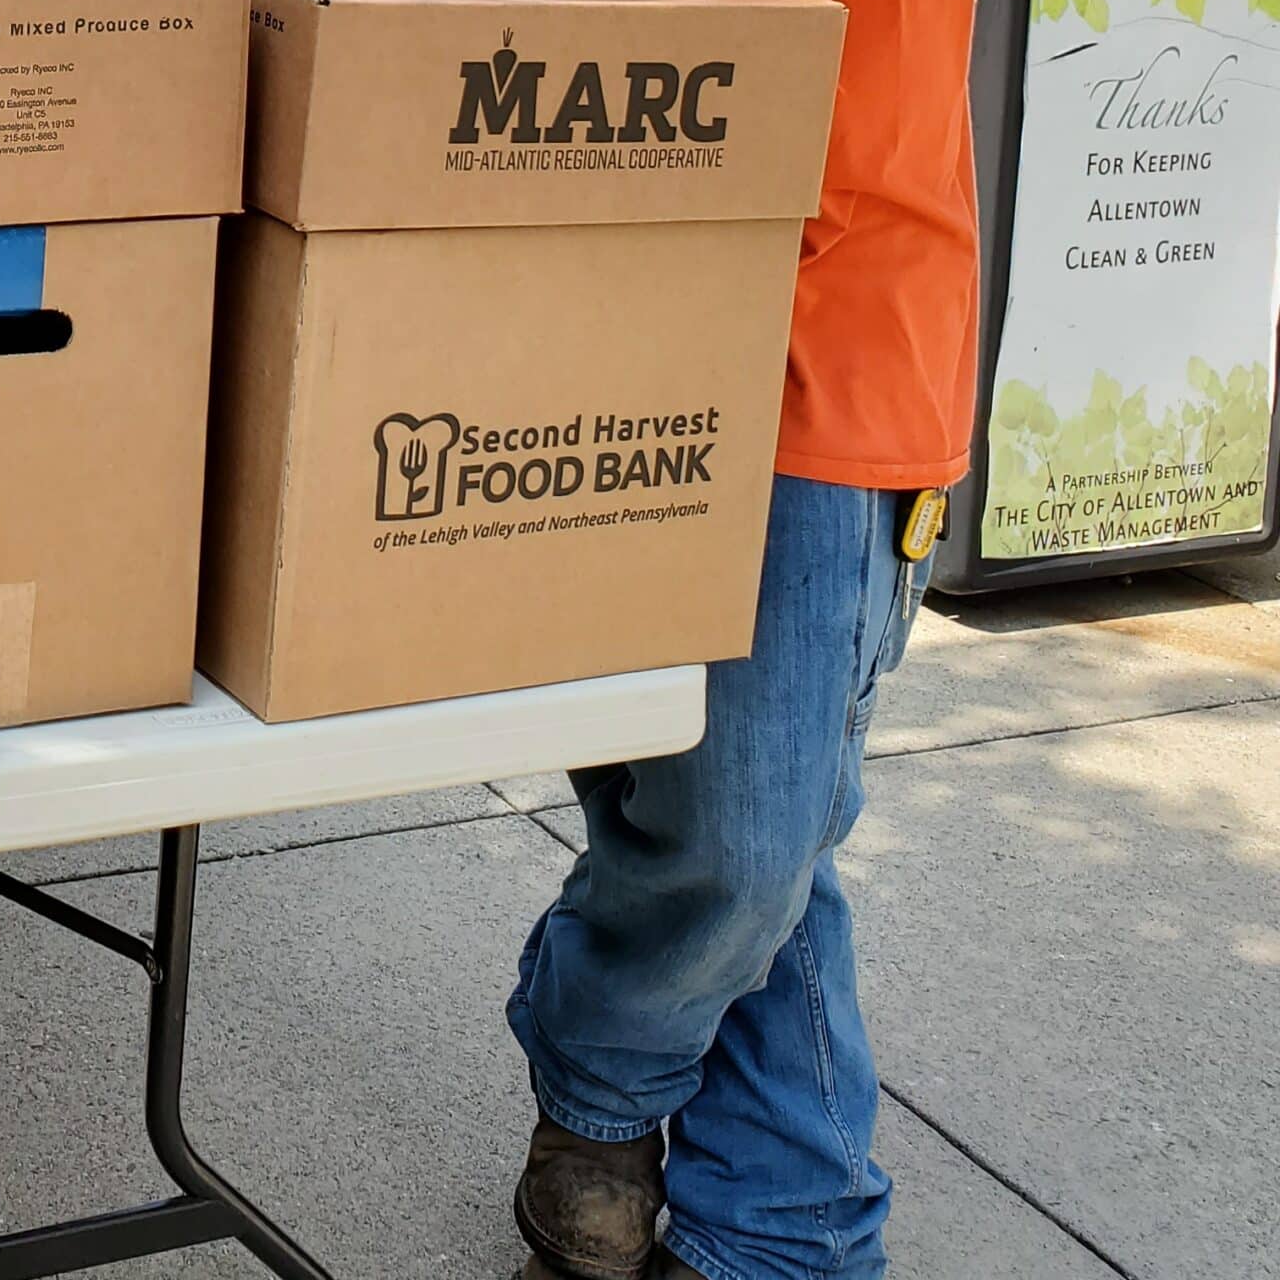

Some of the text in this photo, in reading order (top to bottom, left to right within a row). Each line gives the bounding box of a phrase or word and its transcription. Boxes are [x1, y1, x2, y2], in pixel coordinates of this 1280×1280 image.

[11, 21, 66, 37] Mixed
[75, 18, 150, 34] Produce
[159, 17, 195, 30] Box
[265, 11, 285, 33] Box
[21, 66, 30, 75] by
[59, 63, 74, 72] INC
[38, 86, 53, 95] INC
[449, 49, 735, 144] MARC
[1089, 46, 1238, 129] Thanks
[48, 98, 77, 106] Avenue
[17, 111, 32, 119] Unit
[38, 121, 49, 129] PA
[445, 148, 724, 171] MID-ATLANTIC REGIONAL COOPERATIVE
[1135, 248, 1147, 265] &
[461, 407, 719, 455] Second Harvest
[456, 443, 716, 506] FOOD BANK
[1046, 477, 1056, 493] A
[373, 500, 709, 552] of the Lehigh Valley and Northeast Pennsylvania
